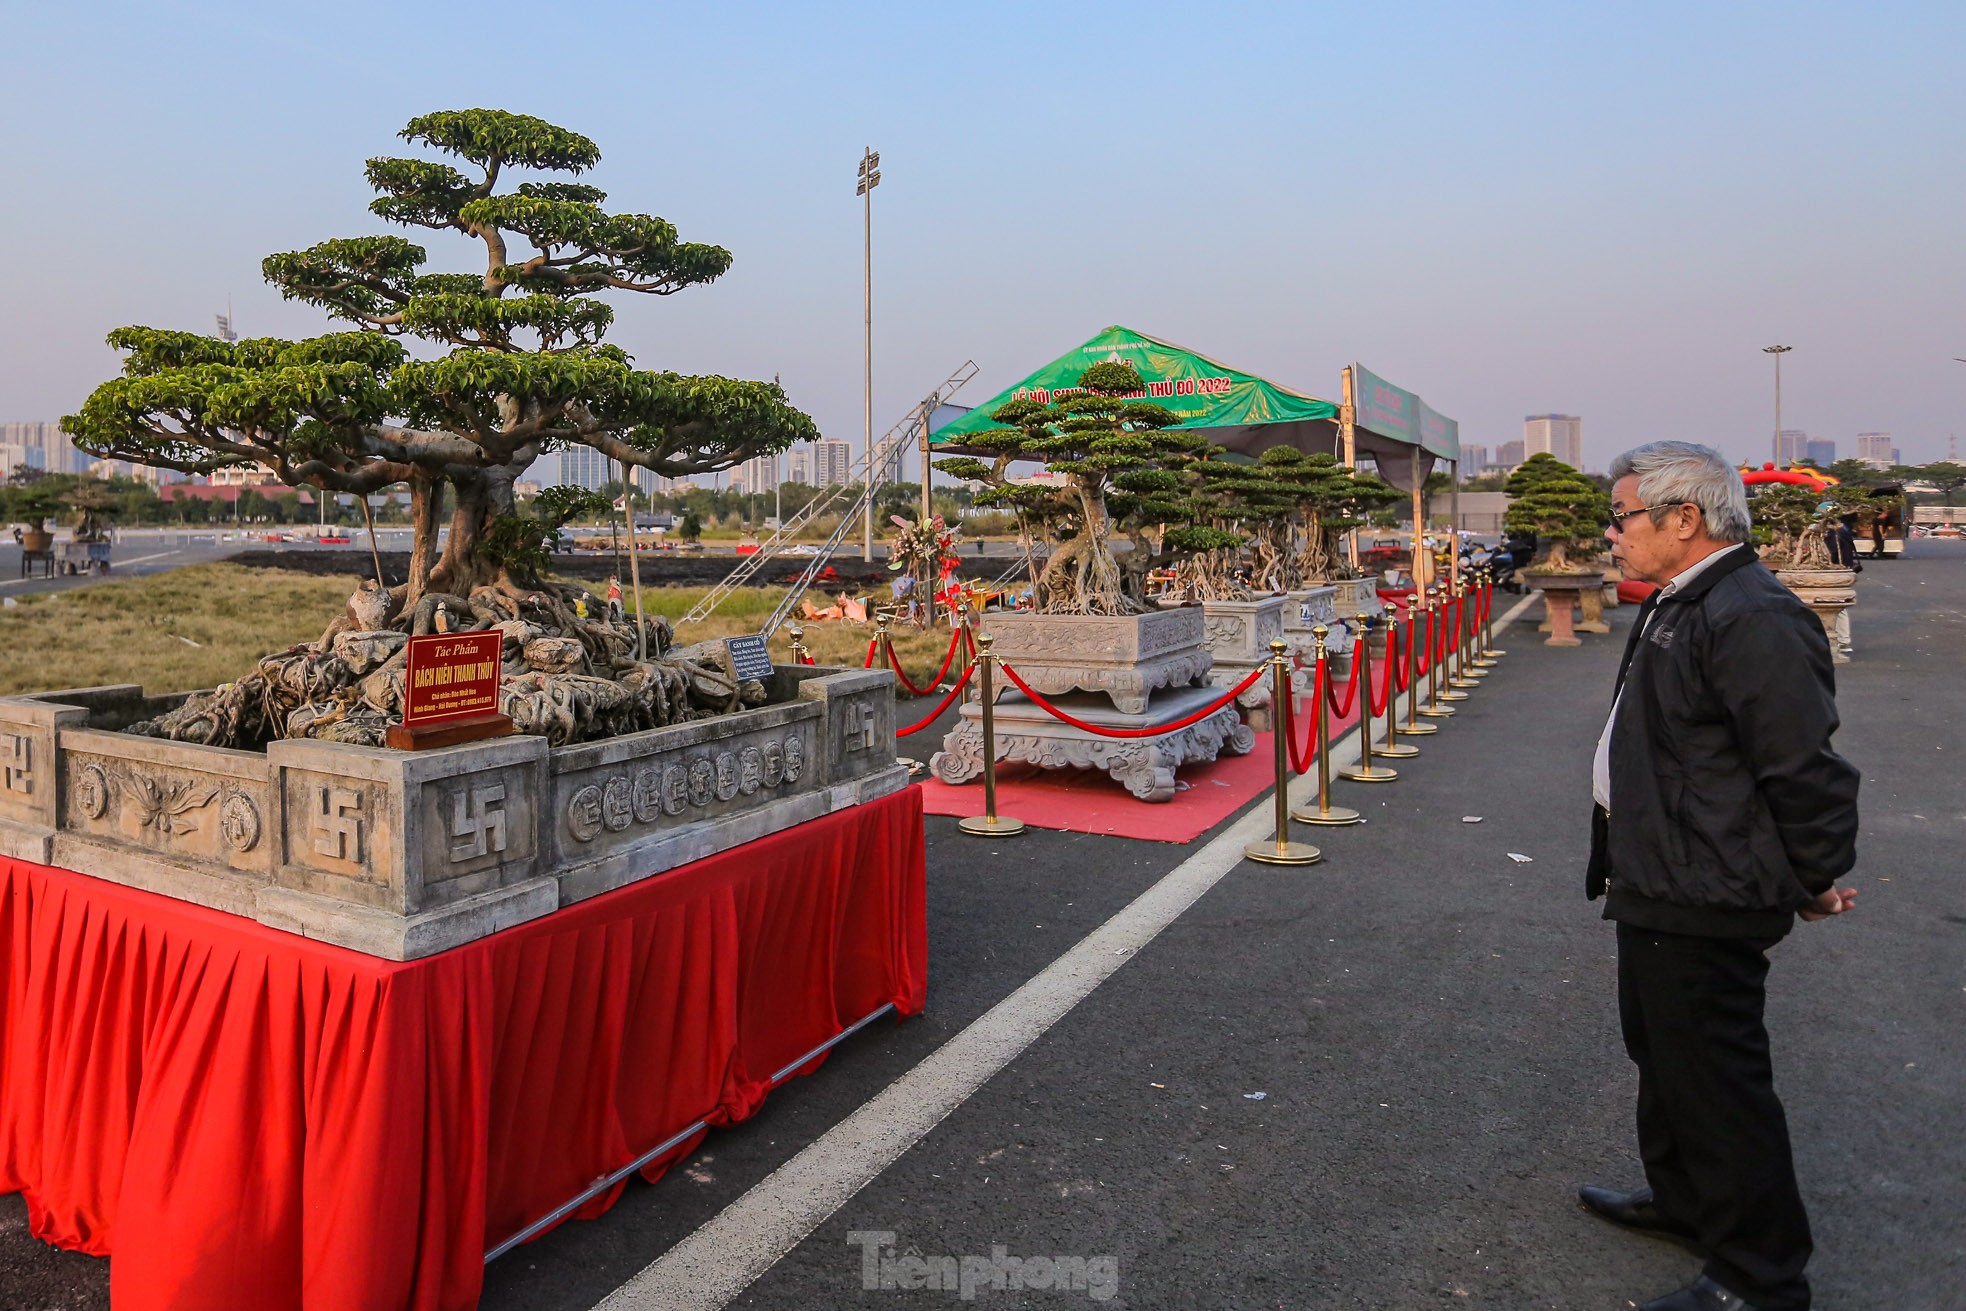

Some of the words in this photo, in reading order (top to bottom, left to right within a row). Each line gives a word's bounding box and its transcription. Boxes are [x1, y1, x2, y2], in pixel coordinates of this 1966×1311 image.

[1148, 376, 1173, 397] THỦ
[1176, 376, 1194, 395] ĐÔ
[1197, 377, 1231, 394] 2022
[435, 646, 451, 657] Tác
[453, 640, 478, 655] Phẩm
[415, 665, 434, 688] BÁCH
[435, 663, 452, 685] NIÊN
[454, 664, 476, 683] THANH
[478, 656, 494, 680] THỦY
